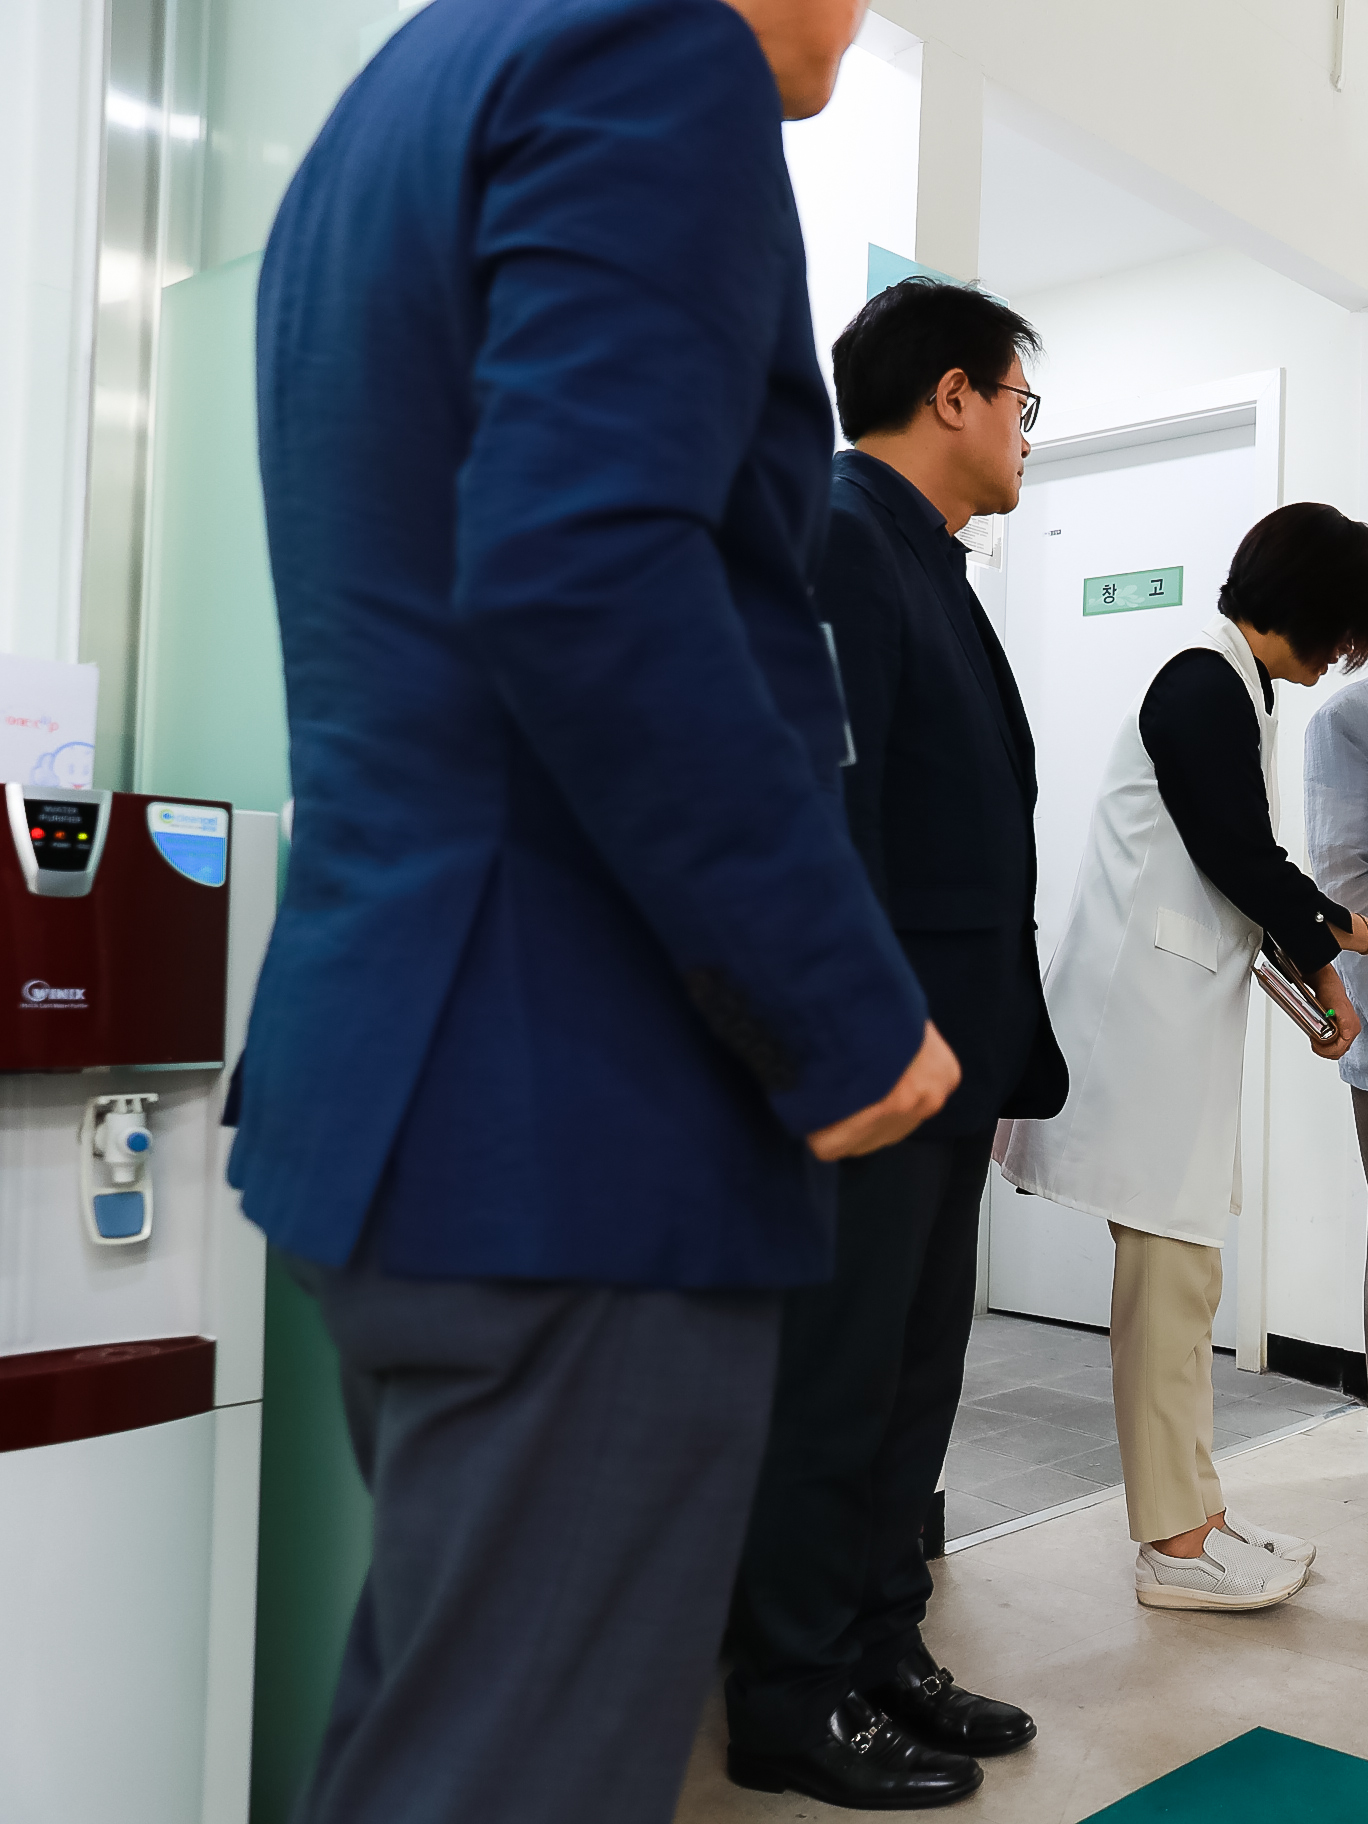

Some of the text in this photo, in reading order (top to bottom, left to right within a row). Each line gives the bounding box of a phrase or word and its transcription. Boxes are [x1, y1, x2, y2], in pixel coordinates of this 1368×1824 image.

[1101, 578, 1165, 604] 창 고
[28, 985, 87, 1001] WINIX
